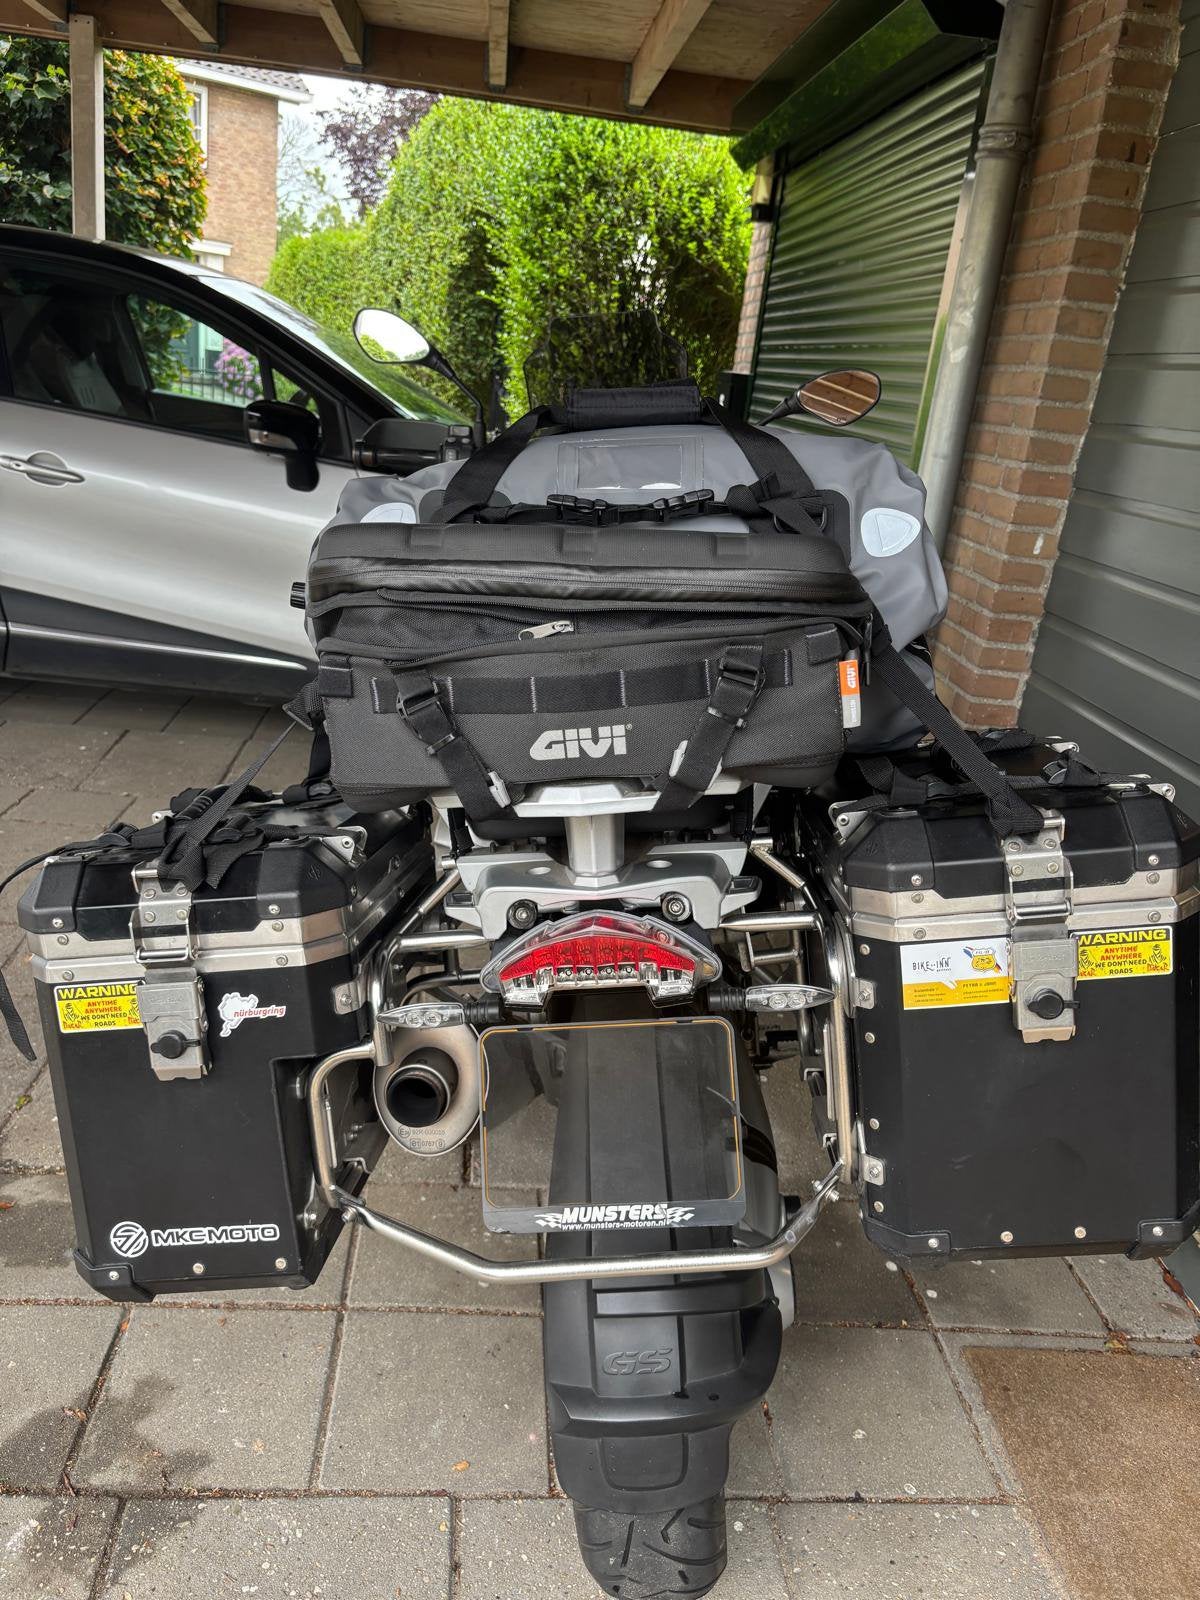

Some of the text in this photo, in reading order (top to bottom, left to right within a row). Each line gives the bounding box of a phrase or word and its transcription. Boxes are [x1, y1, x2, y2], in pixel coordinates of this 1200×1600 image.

[529, 724, 627, 761] GIVI
[1078, 929, 1167, 945] WARNING
[1104, 946, 1137, 954] ANYTIME
[1100, 953, 1142, 961] ANYWHERE
[87, 999, 118, 1007] ANYTIME
[84, 1006, 122, 1014] ANYWHERE
[234, 1007, 284, 1018] nürburgring
[561, 1204, 667, 1224] MUNSTERS
[561, 1220, 667, 1231] www.munsters-motoren.nl
[152, 1224, 280, 1246] MKCMOTO
[602, 1348, 673, 1375] GS
